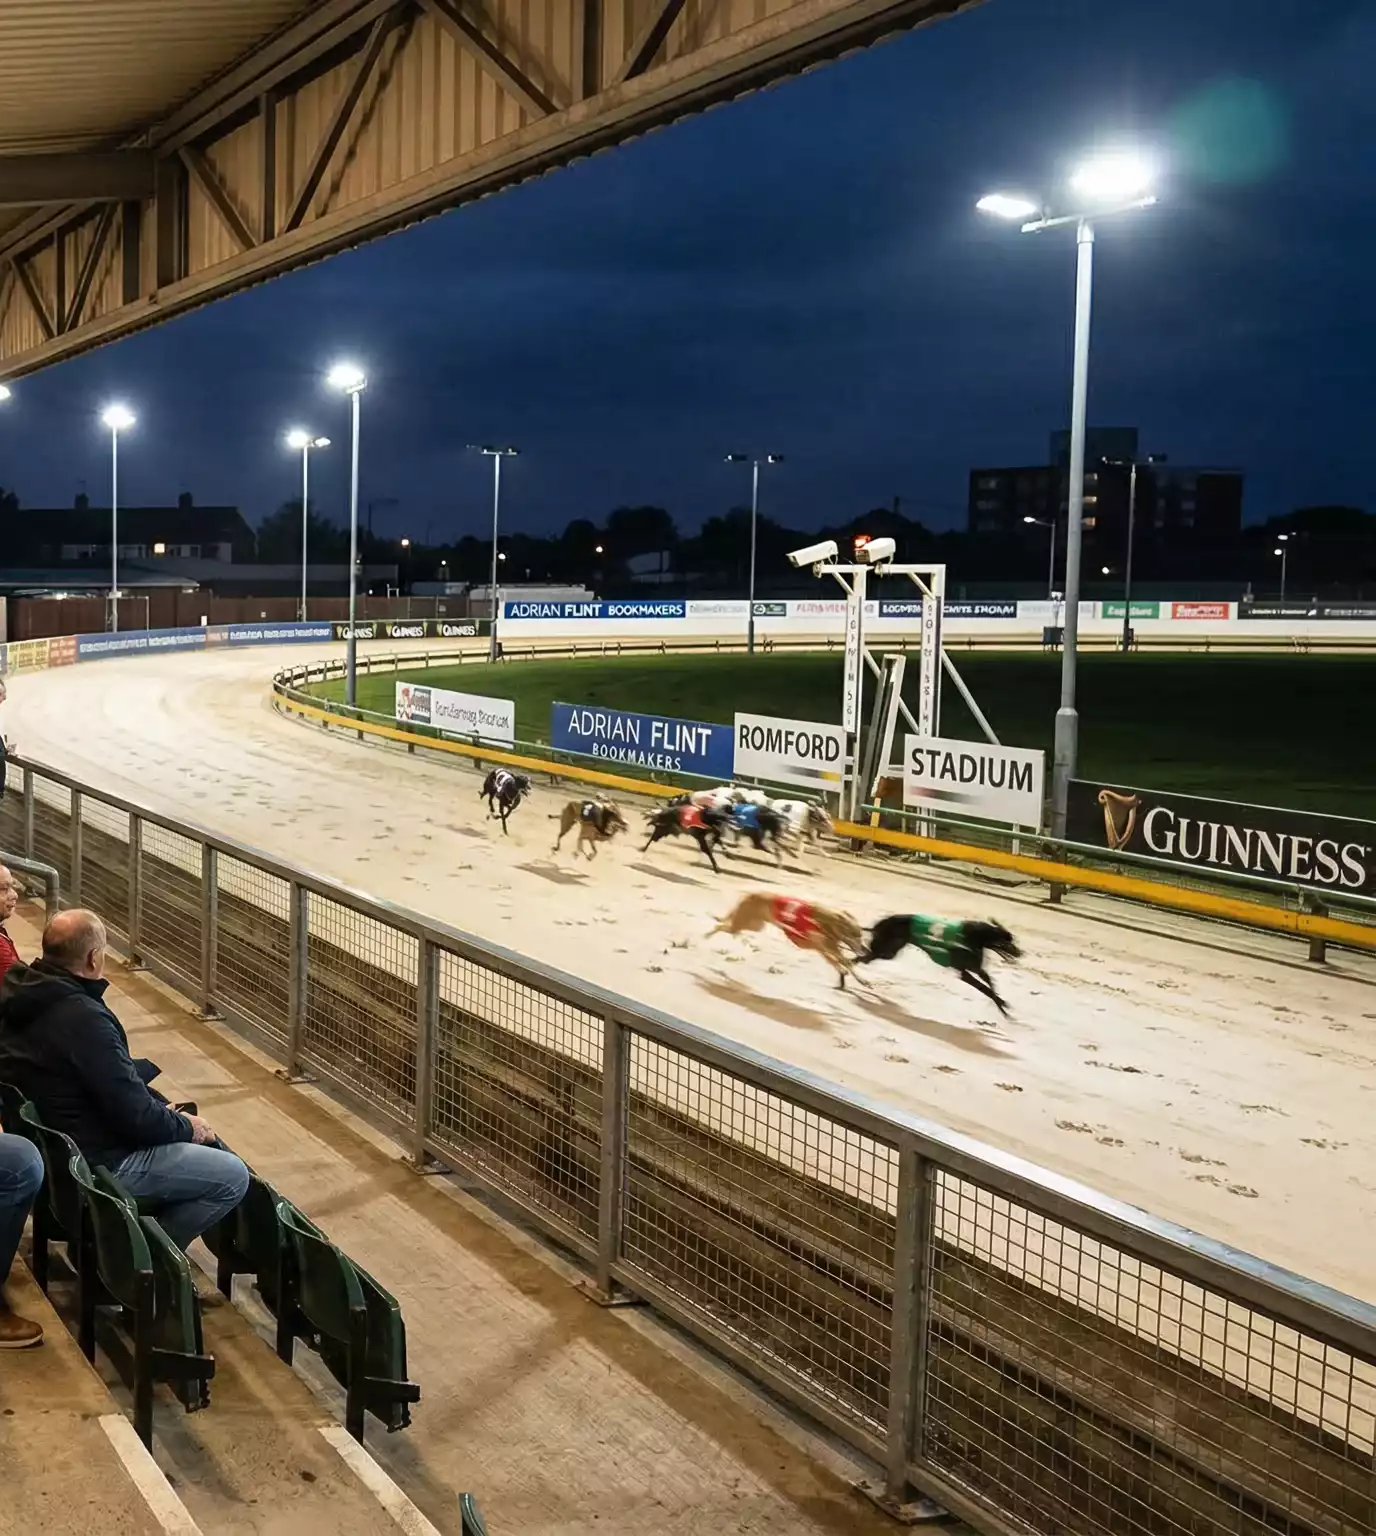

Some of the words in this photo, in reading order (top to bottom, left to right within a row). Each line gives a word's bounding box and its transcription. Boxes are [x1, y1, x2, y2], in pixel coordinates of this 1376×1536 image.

[510, 604, 561, 617] ADRIAN
[565, 604, 602, 617] FLINT
[608, 604, 683, 616] BOOKMAKERS
[568, 709, 640, 745] ADRIAN
[651, 720, 712, 756] FLINT
[739, 724, 841, 762] ROMFORD
[592, 742, 682, 771] BOOKMAKERS
[910, 747, 1034, 793] STADIUM
[1142, 806, 1367, 888] GUINNESS
